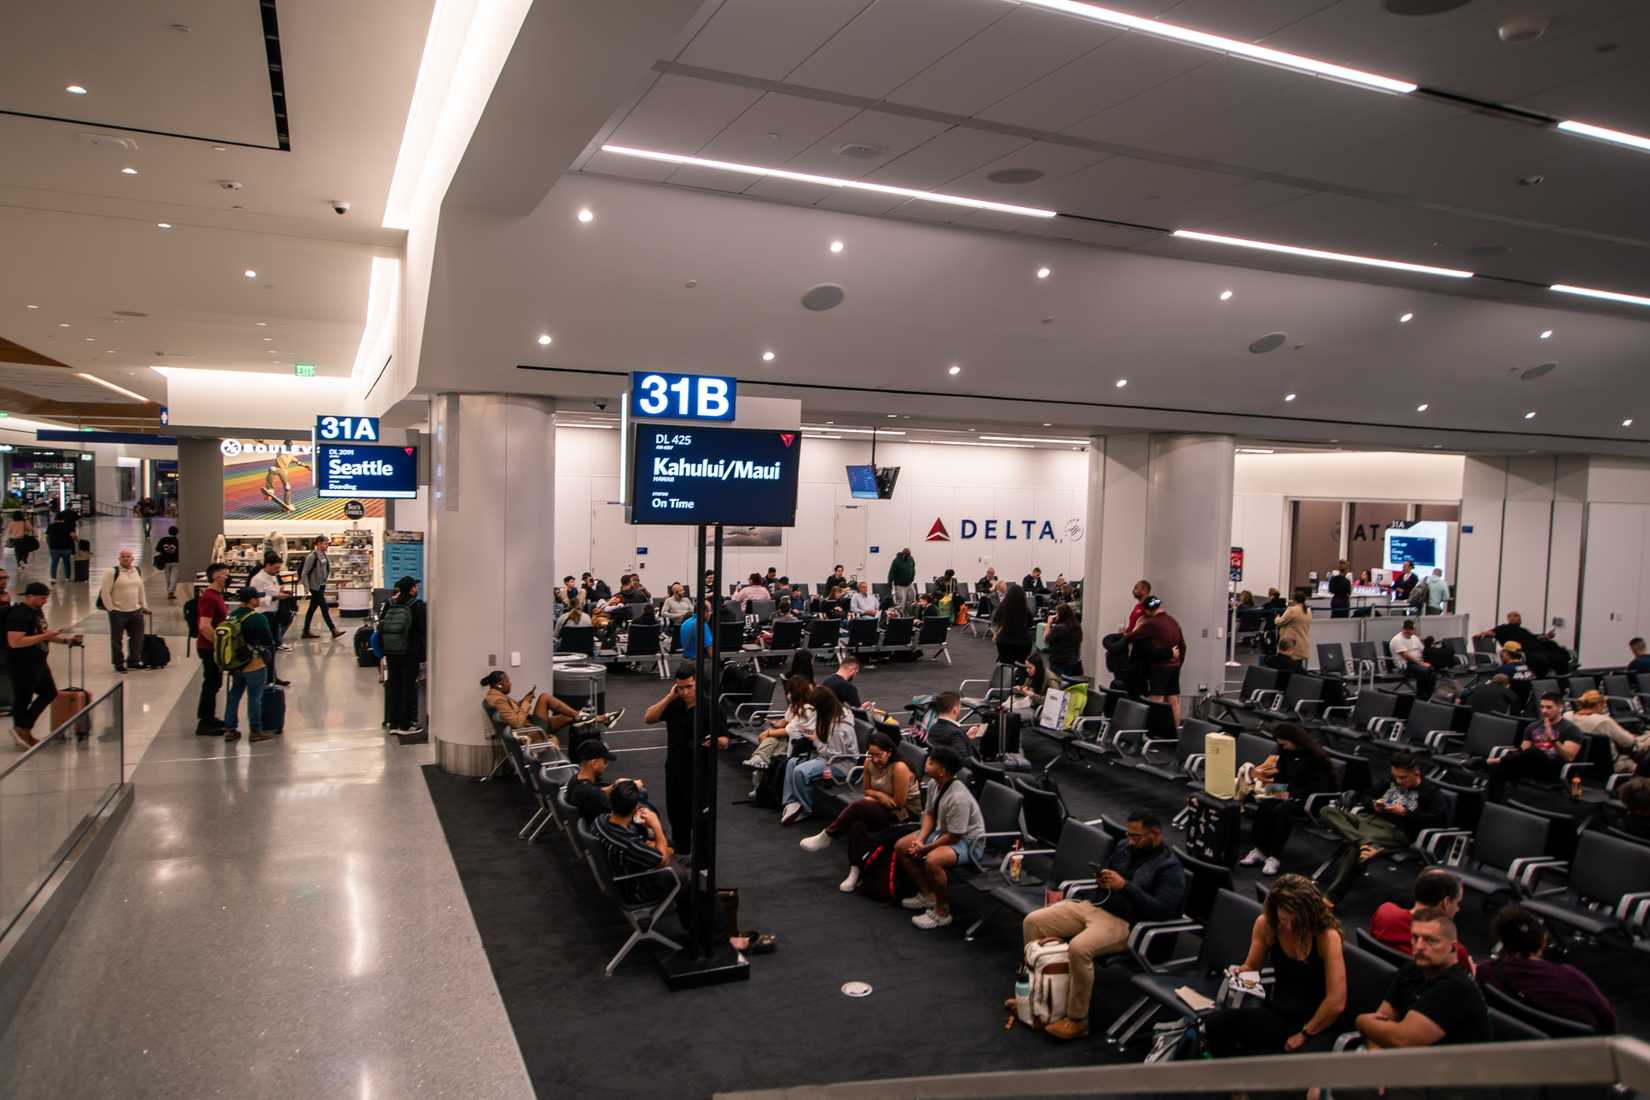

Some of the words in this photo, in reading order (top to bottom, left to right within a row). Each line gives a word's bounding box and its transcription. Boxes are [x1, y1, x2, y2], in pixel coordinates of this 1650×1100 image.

[640, 374, 729, 417] 31B
[321, 416, 376, 440] 31A
[656, 433, 670, 445] DL
[671, 434, 692, 446] 425
[328, 459, 394, 476] Seattle
[653, 457, 781, 481] Kahului/Maui
[651, 498, 668, 509] On
[669, 498, 695, 510] Time
[960, 519, 1055, 541] DELTA
[1391, 520, 1405, 529] 31A
